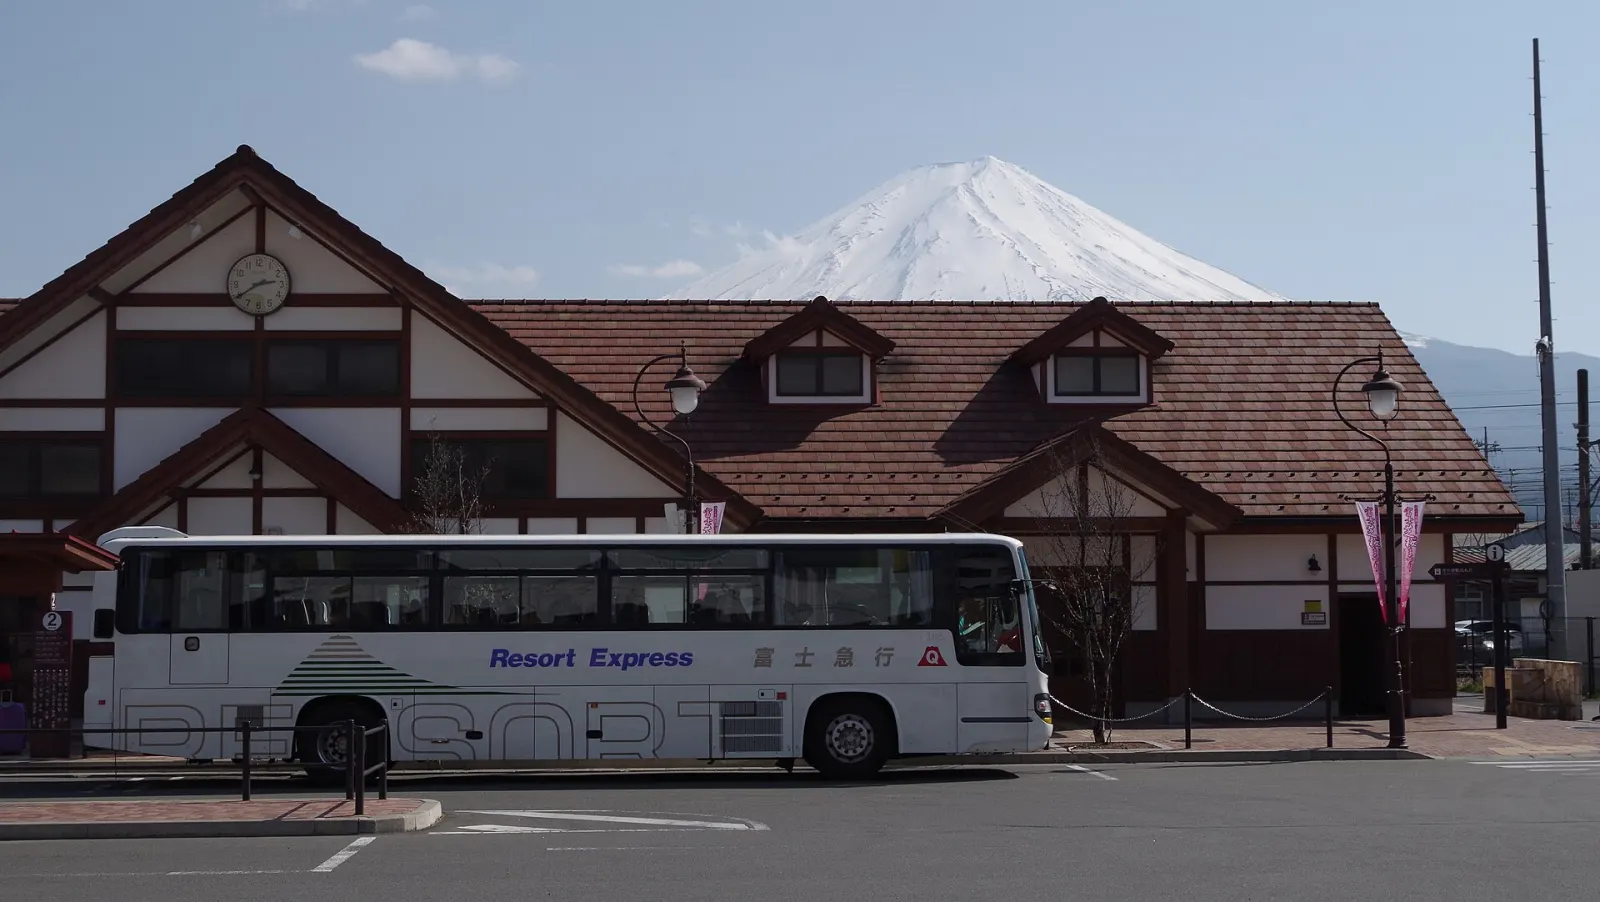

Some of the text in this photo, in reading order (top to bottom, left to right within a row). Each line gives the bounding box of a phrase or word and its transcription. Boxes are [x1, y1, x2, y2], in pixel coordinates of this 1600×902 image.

[256, 259, 264, 267] 12
[236, 269, 244, 277] 10
[275, 269, 281, 278] 2
[275, 291, 281, 299] 4
[245, 298, 251, 306] 7
[256, 301, 261, 309] 6
[267, 298, 272, 307] 5
[48, 613, 57, 626] 2
[489, 648, 693, 671] Resort Express
[753, 646, 895, 668] 富士急行
[925, 650, 939, 664] Q
